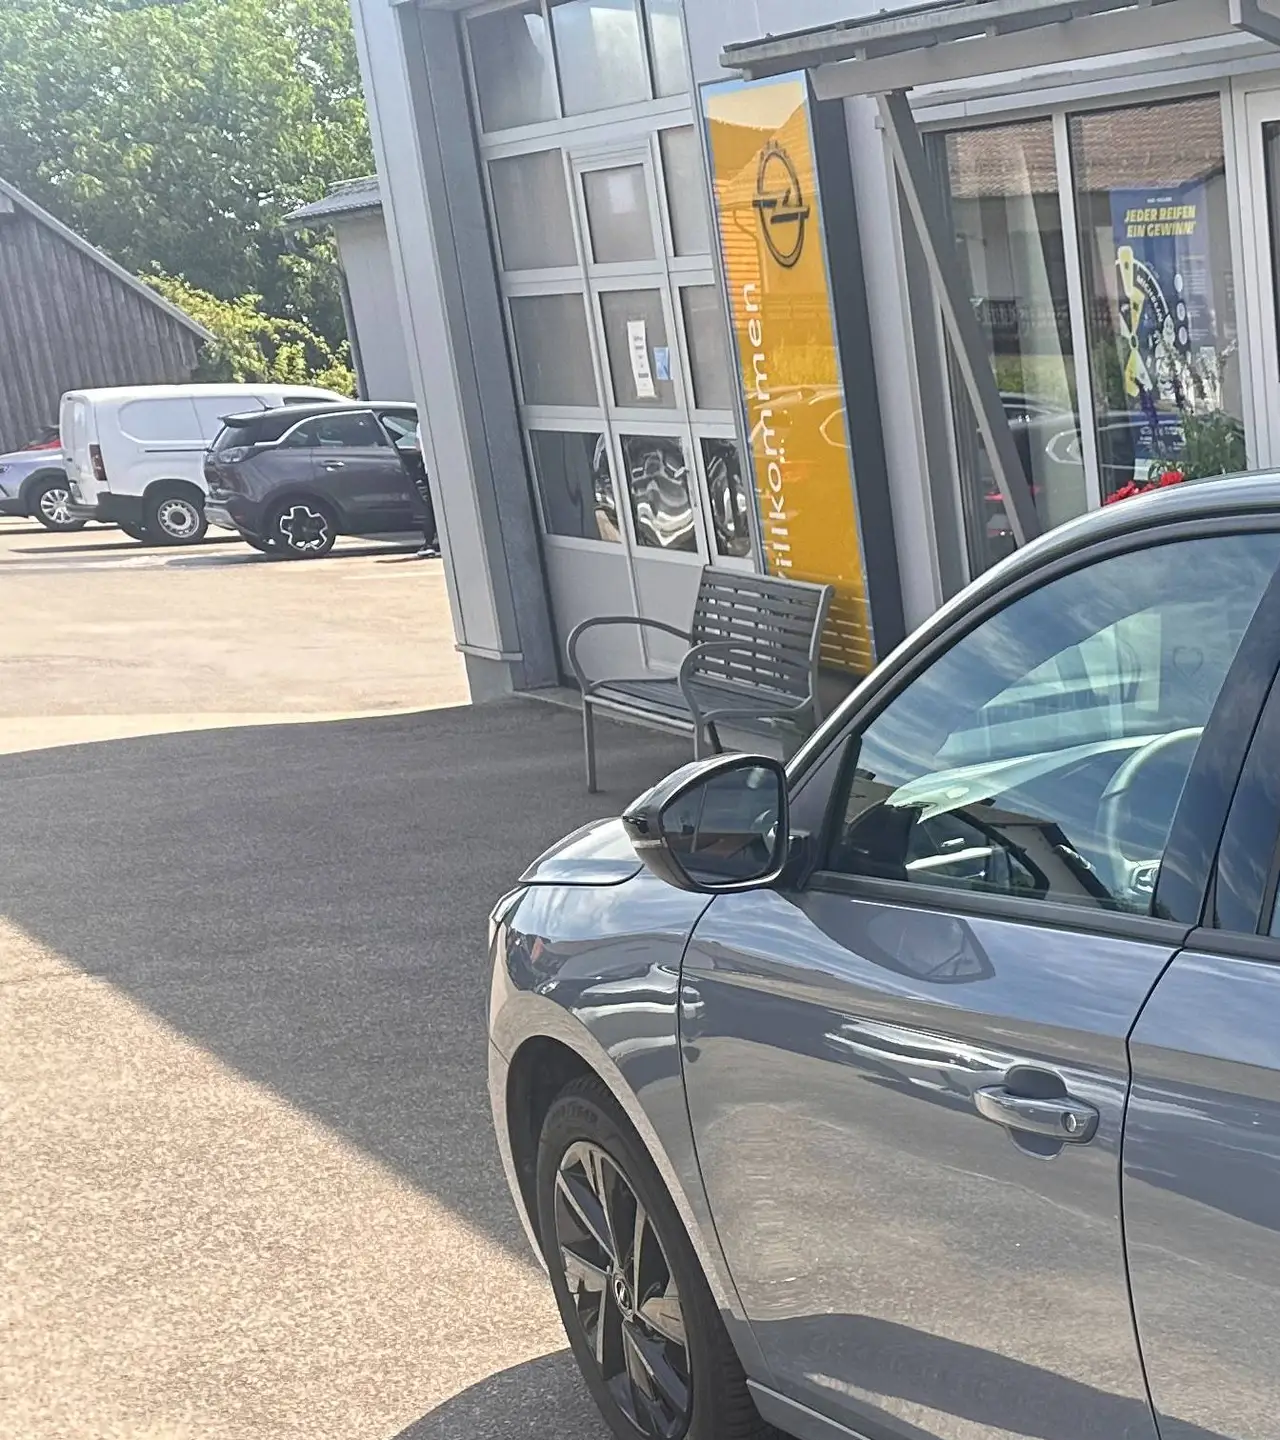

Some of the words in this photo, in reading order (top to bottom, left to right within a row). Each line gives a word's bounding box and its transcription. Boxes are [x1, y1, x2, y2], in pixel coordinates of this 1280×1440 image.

[1124, 208, 1158, 223] JEDER
[1158, 205, 1197, 220] REIFEN
[1126, 223, 1146, 238] EIN
[742, 282, 793, 578] illkommen
